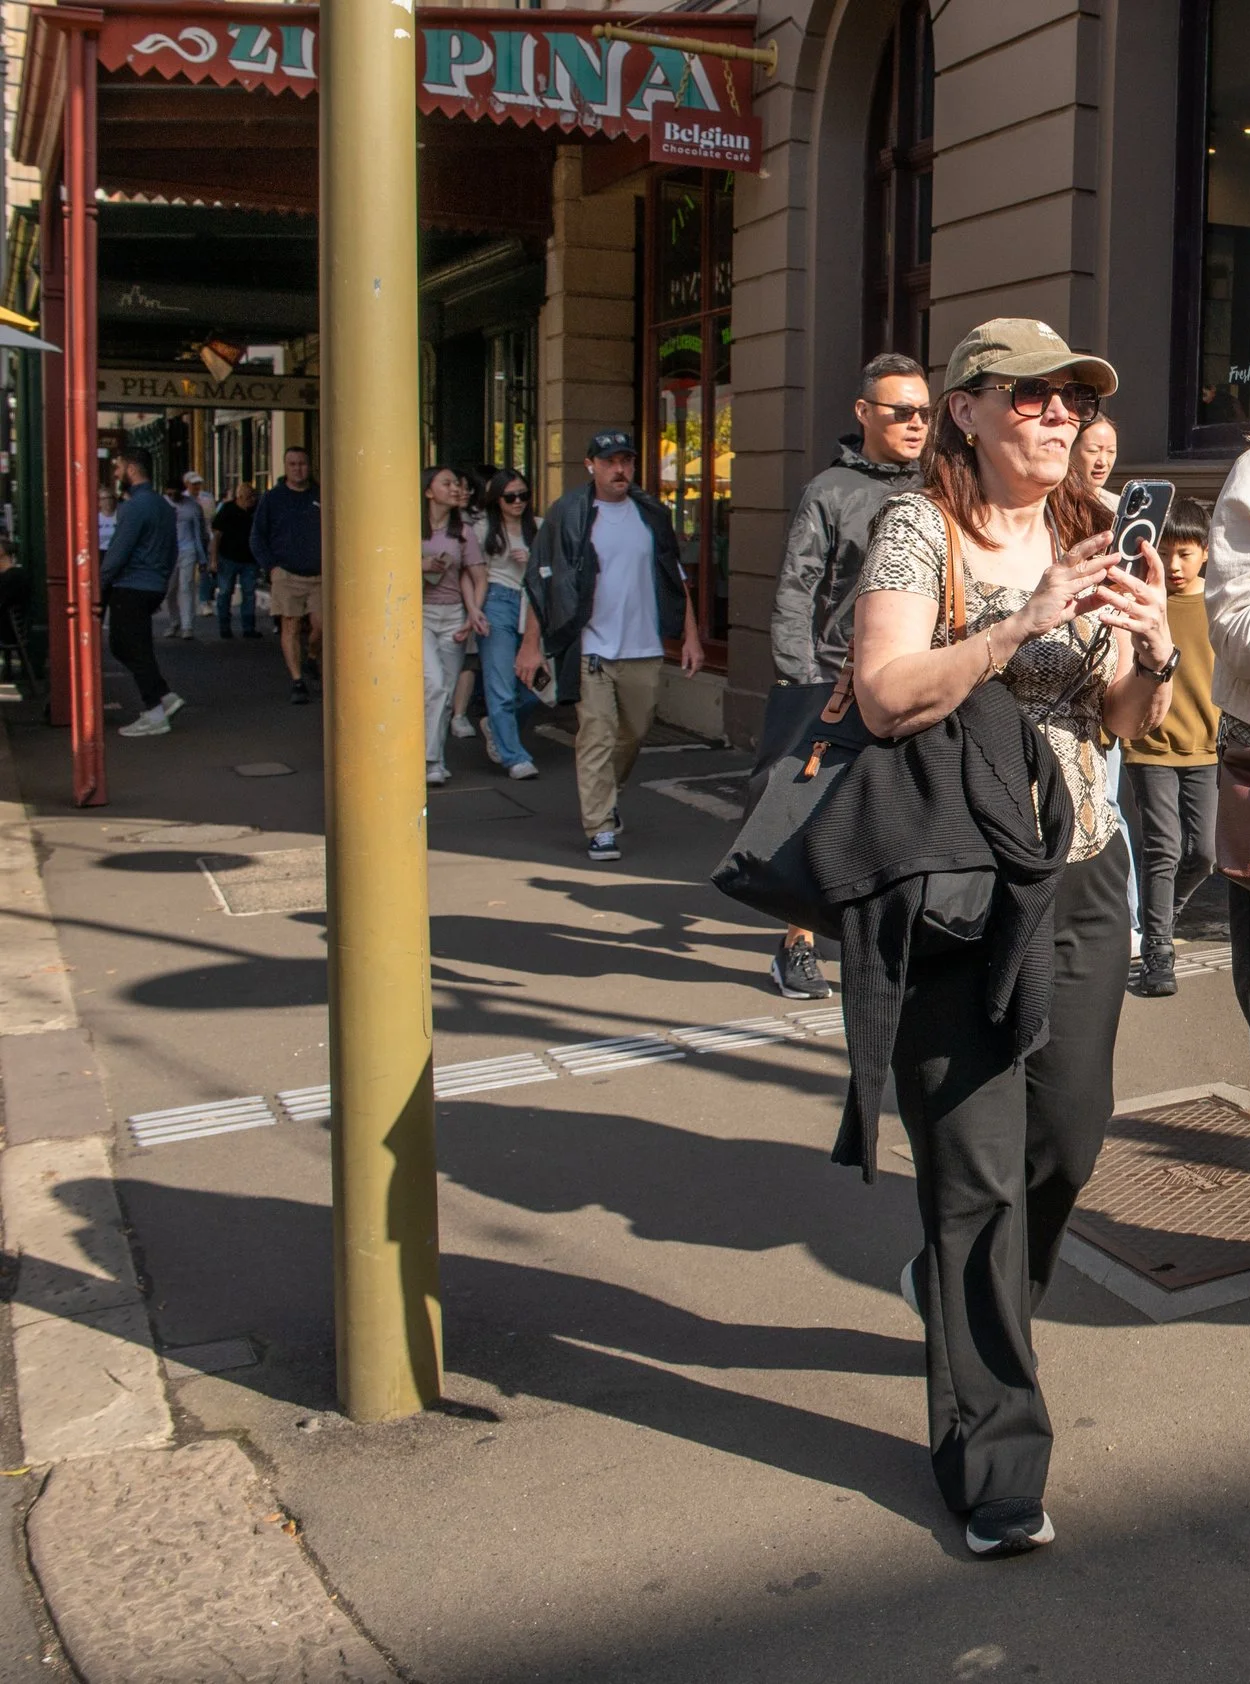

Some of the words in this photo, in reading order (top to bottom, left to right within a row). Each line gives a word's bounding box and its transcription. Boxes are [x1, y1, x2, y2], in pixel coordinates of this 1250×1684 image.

[228, 23, 318, 79] ZI
[421, 28, 720, 121] PINA
[664, 121, 750, 150] Belgian
[662, 143, 721, 159] Chocolate
[725, 151, 751, 162] Café
